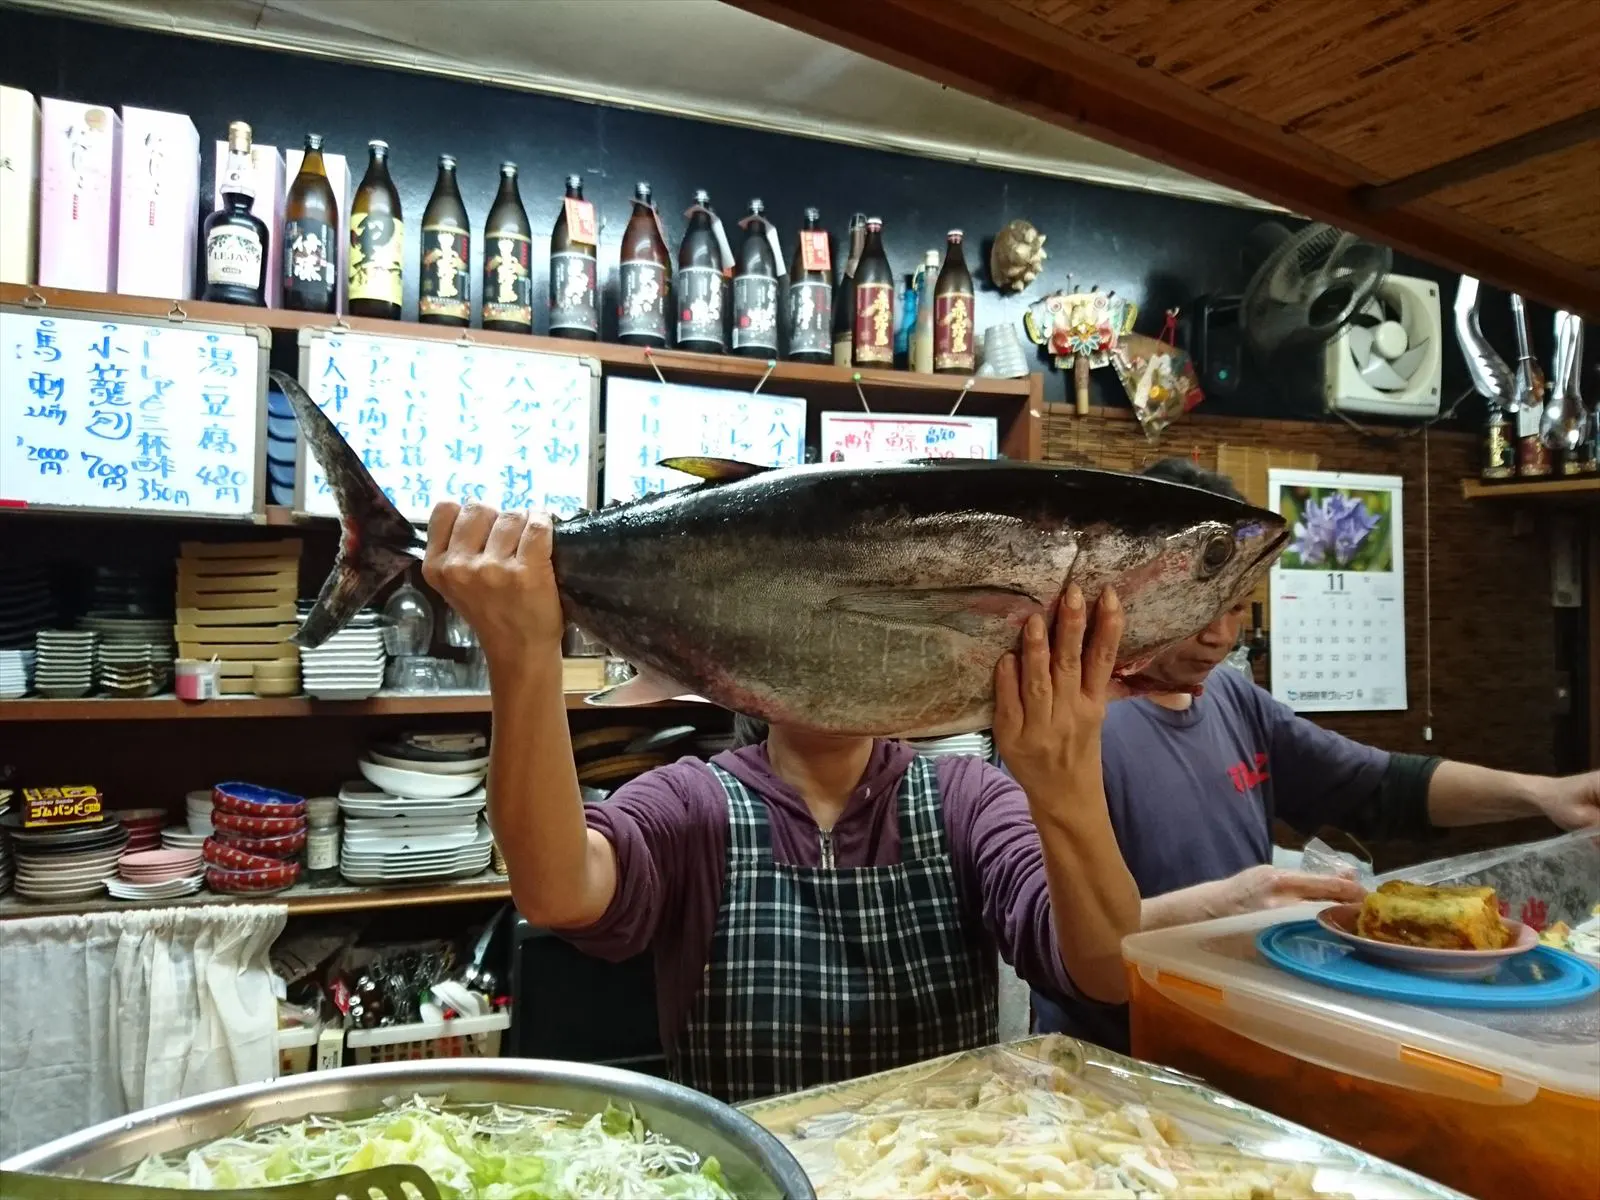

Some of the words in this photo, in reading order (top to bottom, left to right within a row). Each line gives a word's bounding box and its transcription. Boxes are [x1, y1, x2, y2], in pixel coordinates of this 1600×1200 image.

[213, 251, 250, 264] LEJAY
[195, 345, 239, 455] 湯豆腐
[195, 463, 247, 505] 480円
[1327, 573, 1344, 591] 11
[31, 804, 83, 818] ゴムバンド
